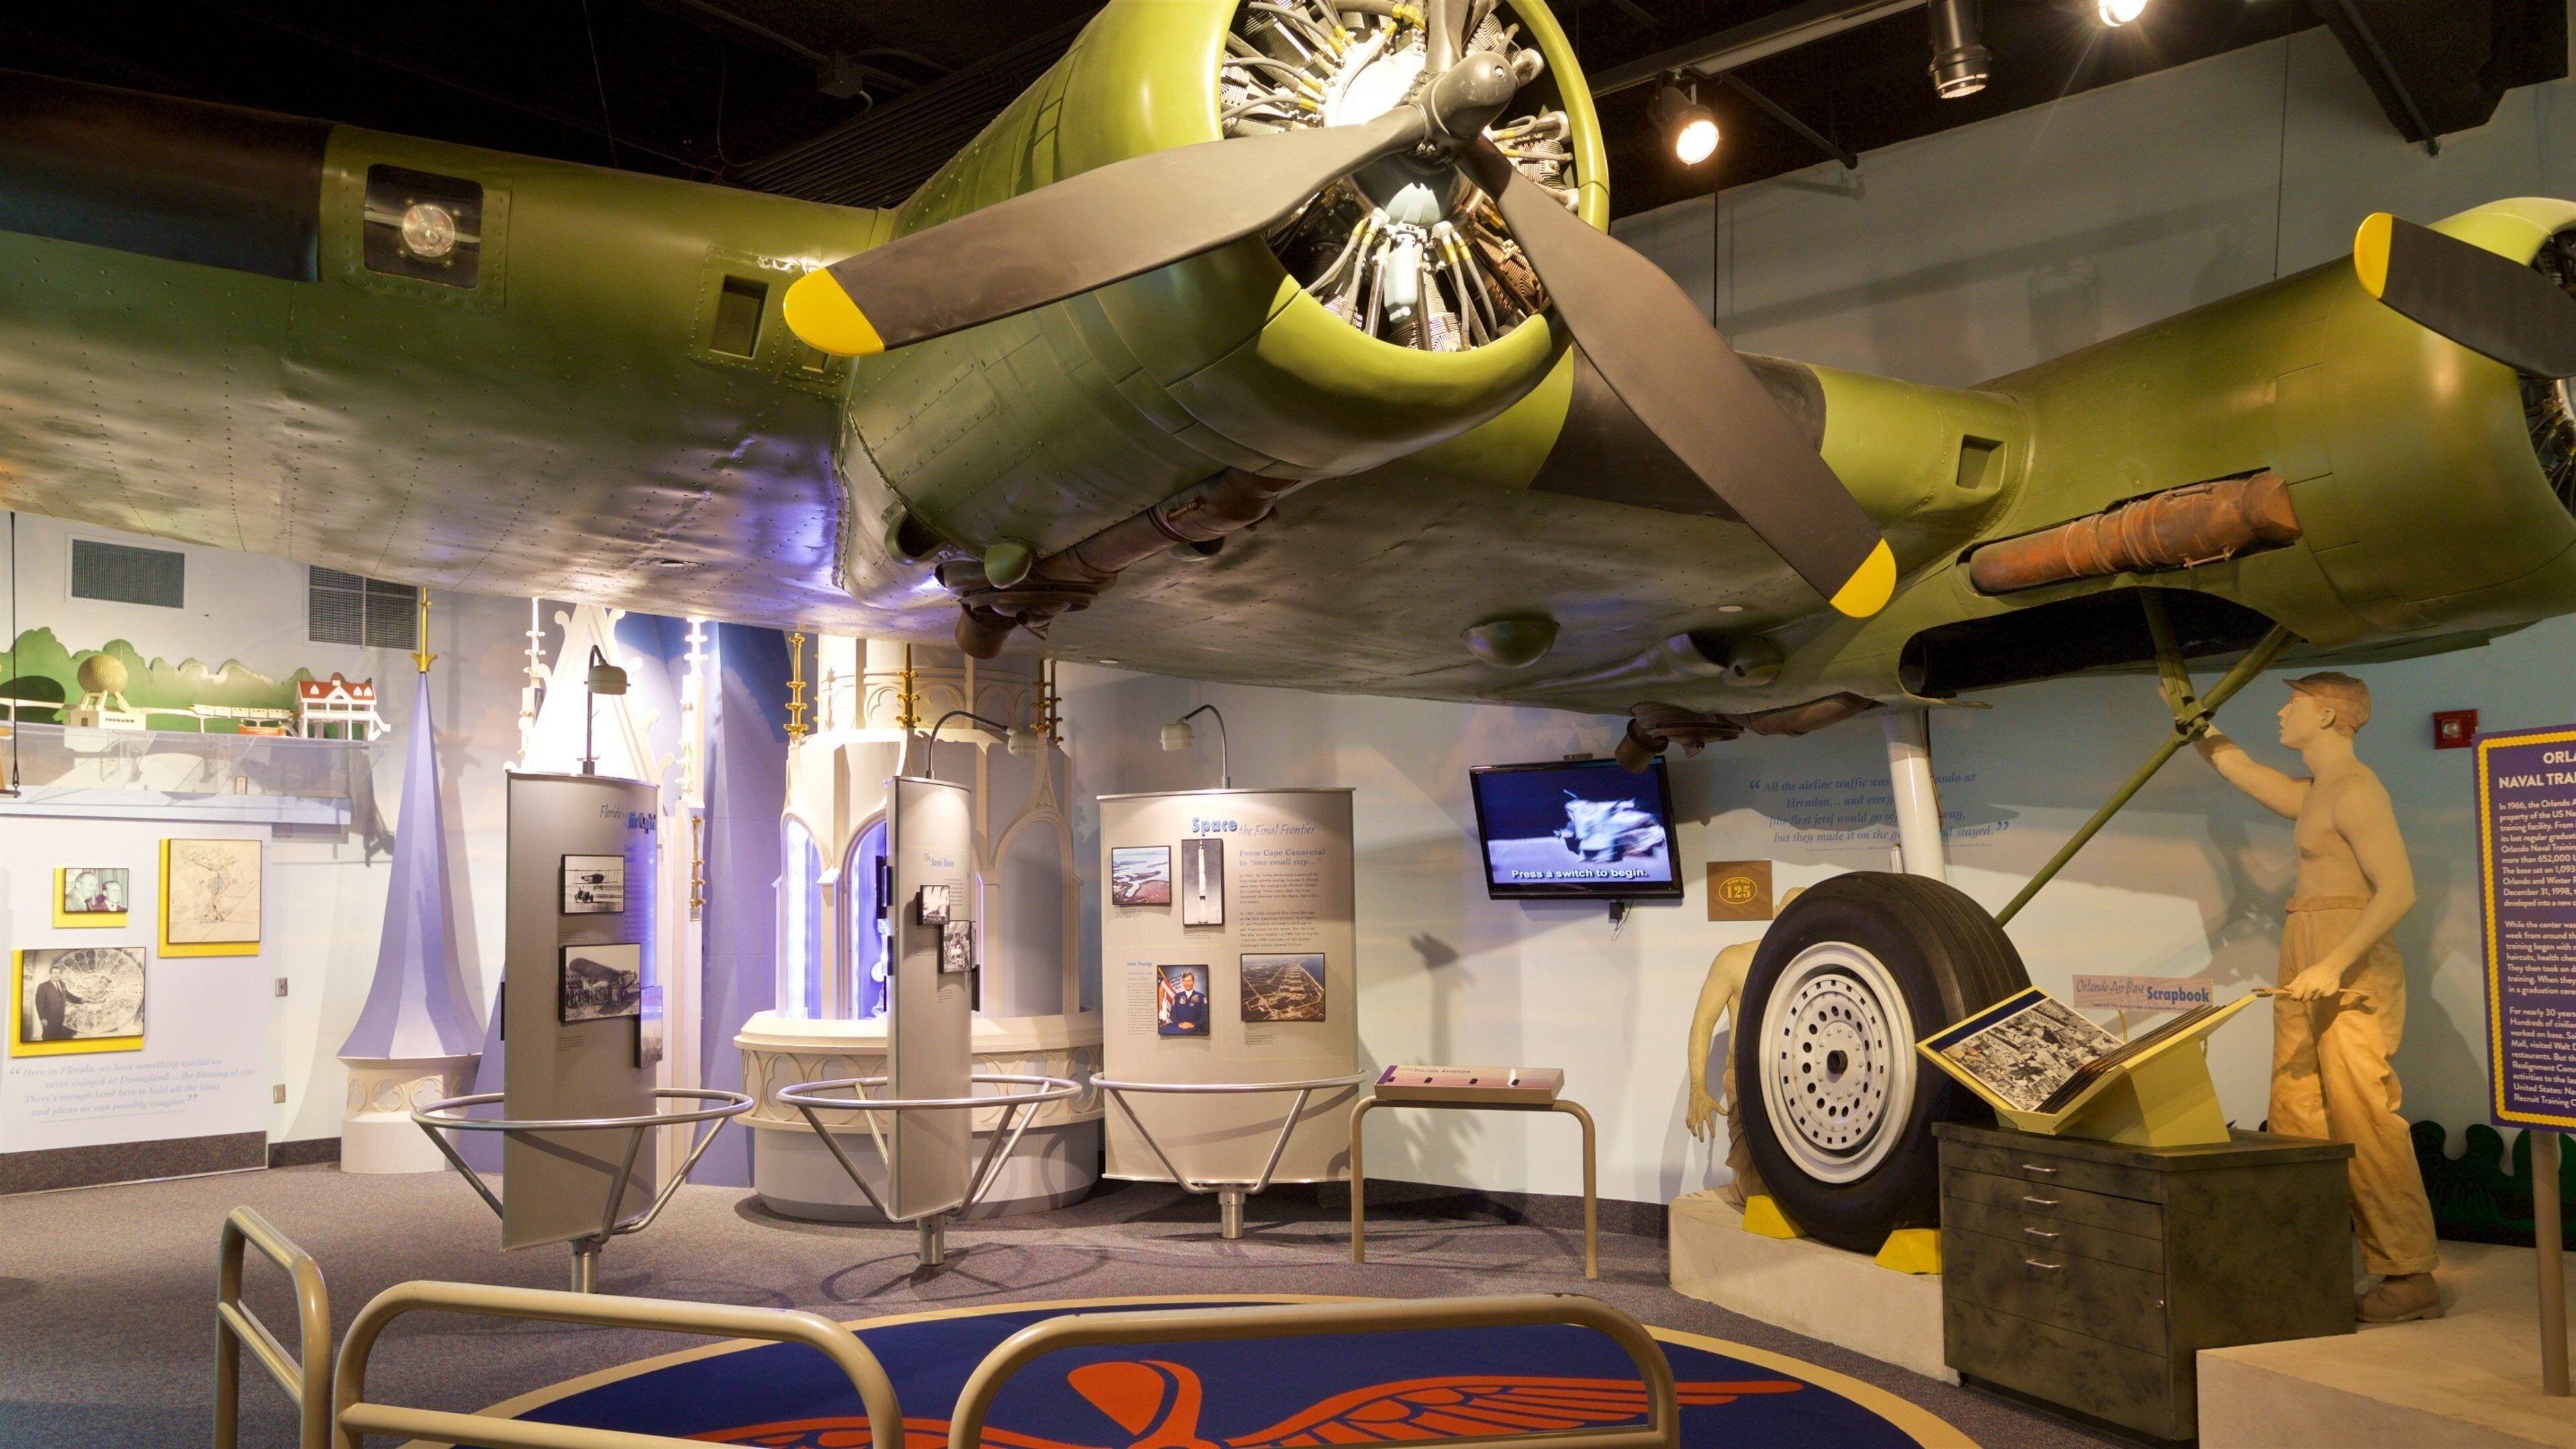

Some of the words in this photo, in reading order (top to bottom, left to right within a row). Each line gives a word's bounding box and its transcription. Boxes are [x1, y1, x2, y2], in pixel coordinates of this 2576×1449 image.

[1782, 781, 1795, 792] the
[1799, 780, 1831, 790] airline
[1835, 777, 1866, 790] traffic
[1870, 778, 1890, 786] was
[1964, 773, 1975, 782] at
[2499, 774, 2544, 789] NAVAL
[1786, 798, 1840, 808] Herndon...
[1844, 796, 1864, 805] and
[2541, 799, 2570, 808] Orlando
[1790, 814, 1812, 825] first
[1813, 813, 1834, 827] jets]
[1837, 812, 1867, 822] would
[1869, 814, 1882, 824] go
[2500, 814, 2528, 823] property
[1192, 817, 1237, 836] Space
[1239, 824, 1251, 835] the
[1254, 823, 1278, 836] Final
[1281, 822, 1315, 835] Frontier
[2500, 824, 2526, 833] training
[2528, 822, 2553, 832] facility.
[1774, 833, 1790, 843] but
[1792, 832, 1813, 844] they
[1817, 832, 1843, 841] made
[1847, 830, 1854, 840] it
[1857, 832, 1869, 840] on
[1873, 829, 1888, 839] the
[2524, 833, 2547, 844] regular
[1264, 849, 1283, 857] Cape
[2501, 845, 2529, 853] Orlando
[2538, 855, 2571, 863] 652,000
[1511, 869, 1543, 878] Press
[1556, 869, 1593, 877] switch
[1597, 869, 1609, 877] to
[1611, 868, 1649, 879] begin.
[2555, 865, 2576, 874] 1,093
[1727, 885, 1751, 898] 125
[2540, 888, 2551, 896] 31,
[2552, 888, 2572, 896] 1998,
[2504, 899, 2536, 908] developed
[2506, 942, 2532, 953] training
[2534, 943, 2555, 953] began
[2506, 953, 2536, 962] haircuts,
[2507, 963, 2524, 974] They
[2508, 975, 2536, 985] training.
[2077, 978, 2108, 993] Orlando
[2110, 981, 2124, 994] Air
[2127, 981, 2145, 994] Base
[2147, 986, 2210, 1004] Scrapbook
[2522, 986, 2559, 996] graduation
[2523, 1008, 2544, 1018] nearly
[2510, 1018, 2544, 1026] Hundreds
[2512, 1040, 2528, 1049] Mall,
[2530, 1041, 2552, 1049] visited
[2554, 1042, 2571, 1051] Walt
[2512, 1052, 2552, 1060] restaurants.
[2553, 1053, 2566, 1061] But
[137, 1061, 179, 1069] something
[181, 1059, 209, 1068] special
[2512, 1061, 2555, 1072] Realignment
[72, 1078, 105, 1088] enjoyed
[197, 1071, 228, 1079] blessing
[2513, 1073, 2542, 1081] activities
[2513, 1083, 2537, 1092] United
[2538, 1085, 2563, 1093] States:
[60, 1092, 91, 1102] enough
[95, 1089, 115, 1097] land
[149, 1086, 168, 1094] hold
[2514, 1093, 2539, 1103] Recruit
[2541, 1096, 2569, 1108] Training
[52, 1107, 77, 1117] plans
[113, 1100, 146, 1112] possibly
